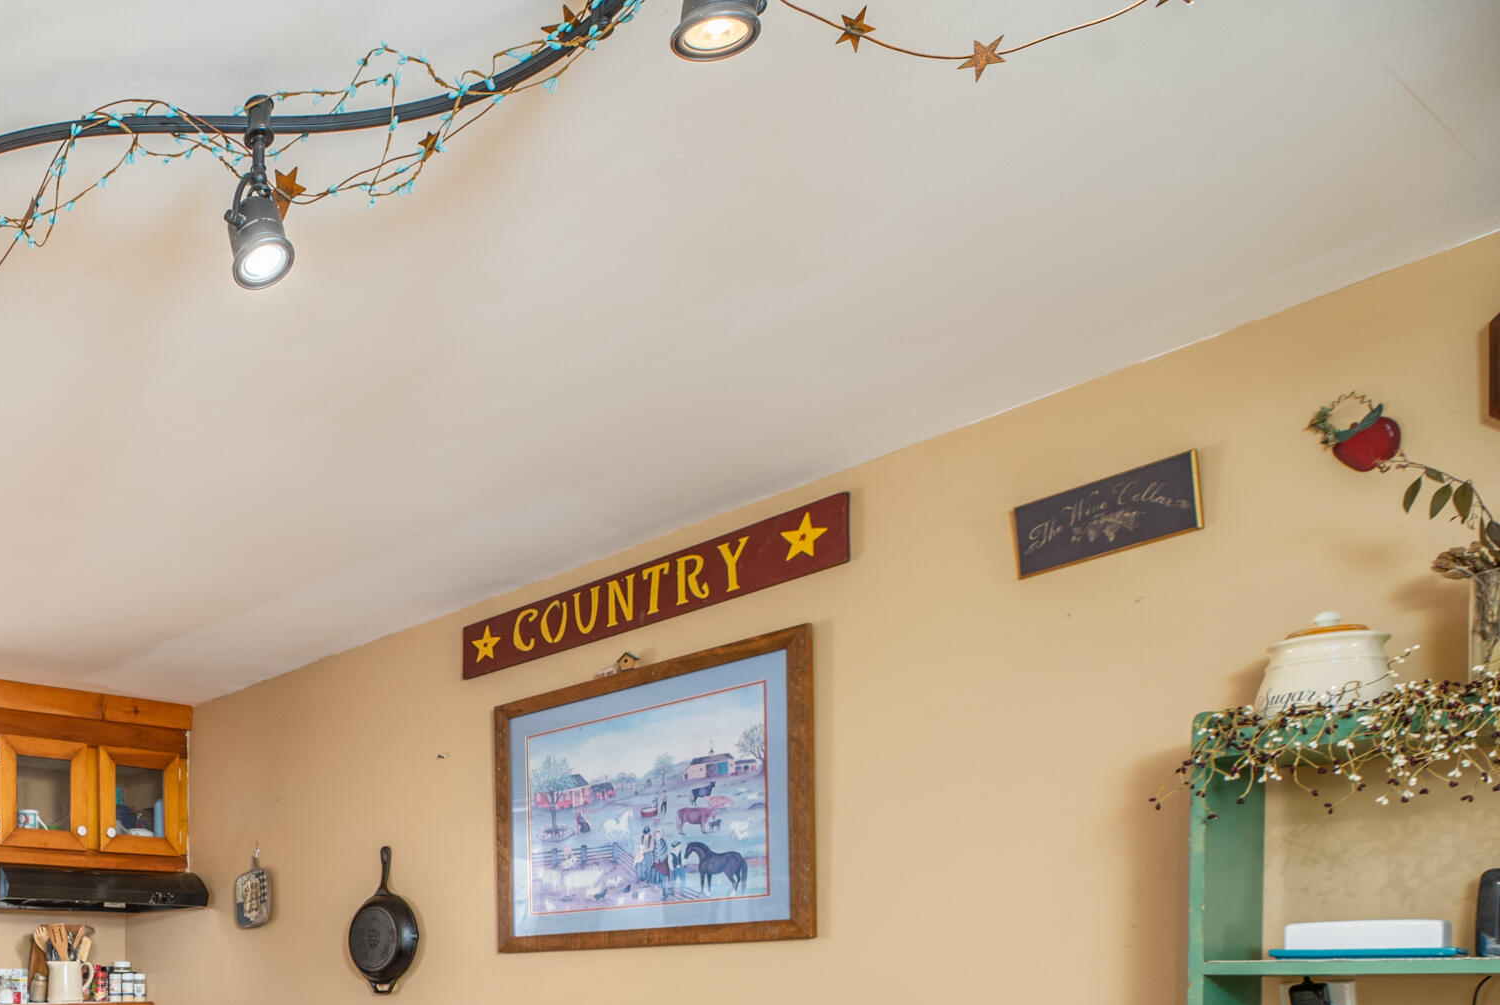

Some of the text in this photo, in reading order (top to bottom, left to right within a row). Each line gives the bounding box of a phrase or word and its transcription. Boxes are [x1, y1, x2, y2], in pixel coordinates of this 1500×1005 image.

[1025, 480, 1176, 555] The Wine Cellar
[513, 535, 749, 652] COUNTRY
[1256, 687, 1316, 717] Sugar
